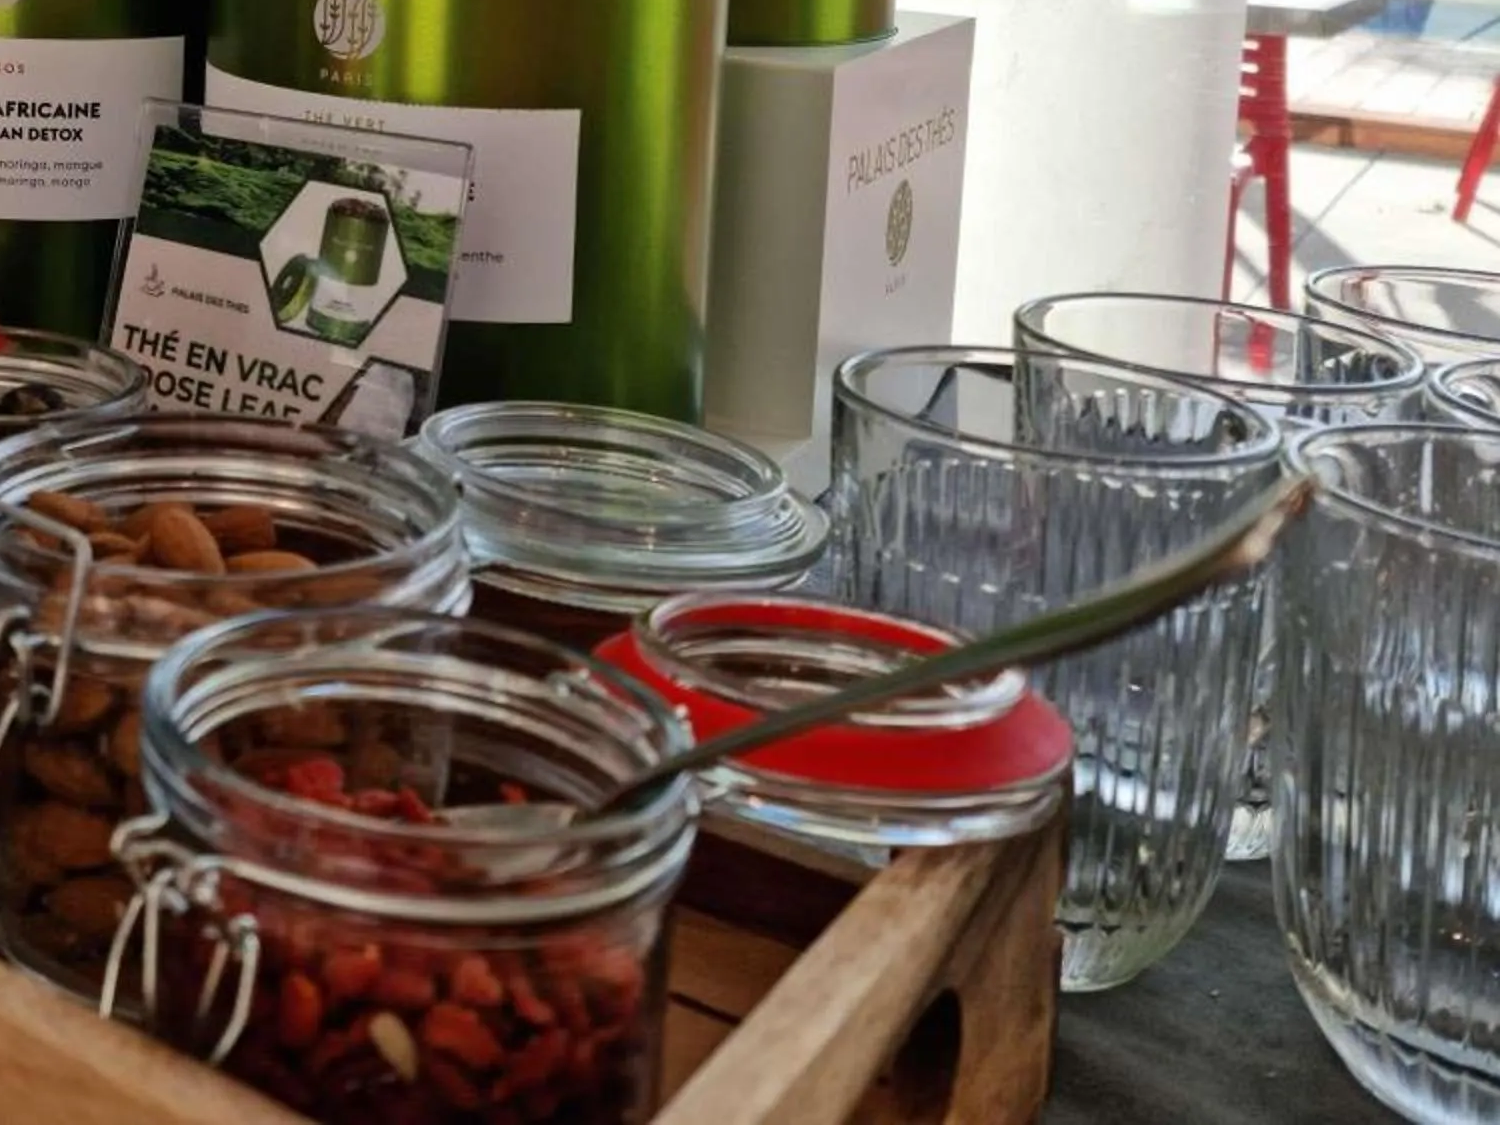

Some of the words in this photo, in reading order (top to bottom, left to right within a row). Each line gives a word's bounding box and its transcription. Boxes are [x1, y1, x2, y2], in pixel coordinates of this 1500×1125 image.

[27, 126, 84, 143] DETOX
[846, 136, 896, 193] PALAIS
[898, 123, 924, 168] DES
[460, 250, 505, 263] enthe
[122, 323, 180, 362] THÉ
[185, 340, 229, 377] EN
[236, 353, 325, 403] VRAC
